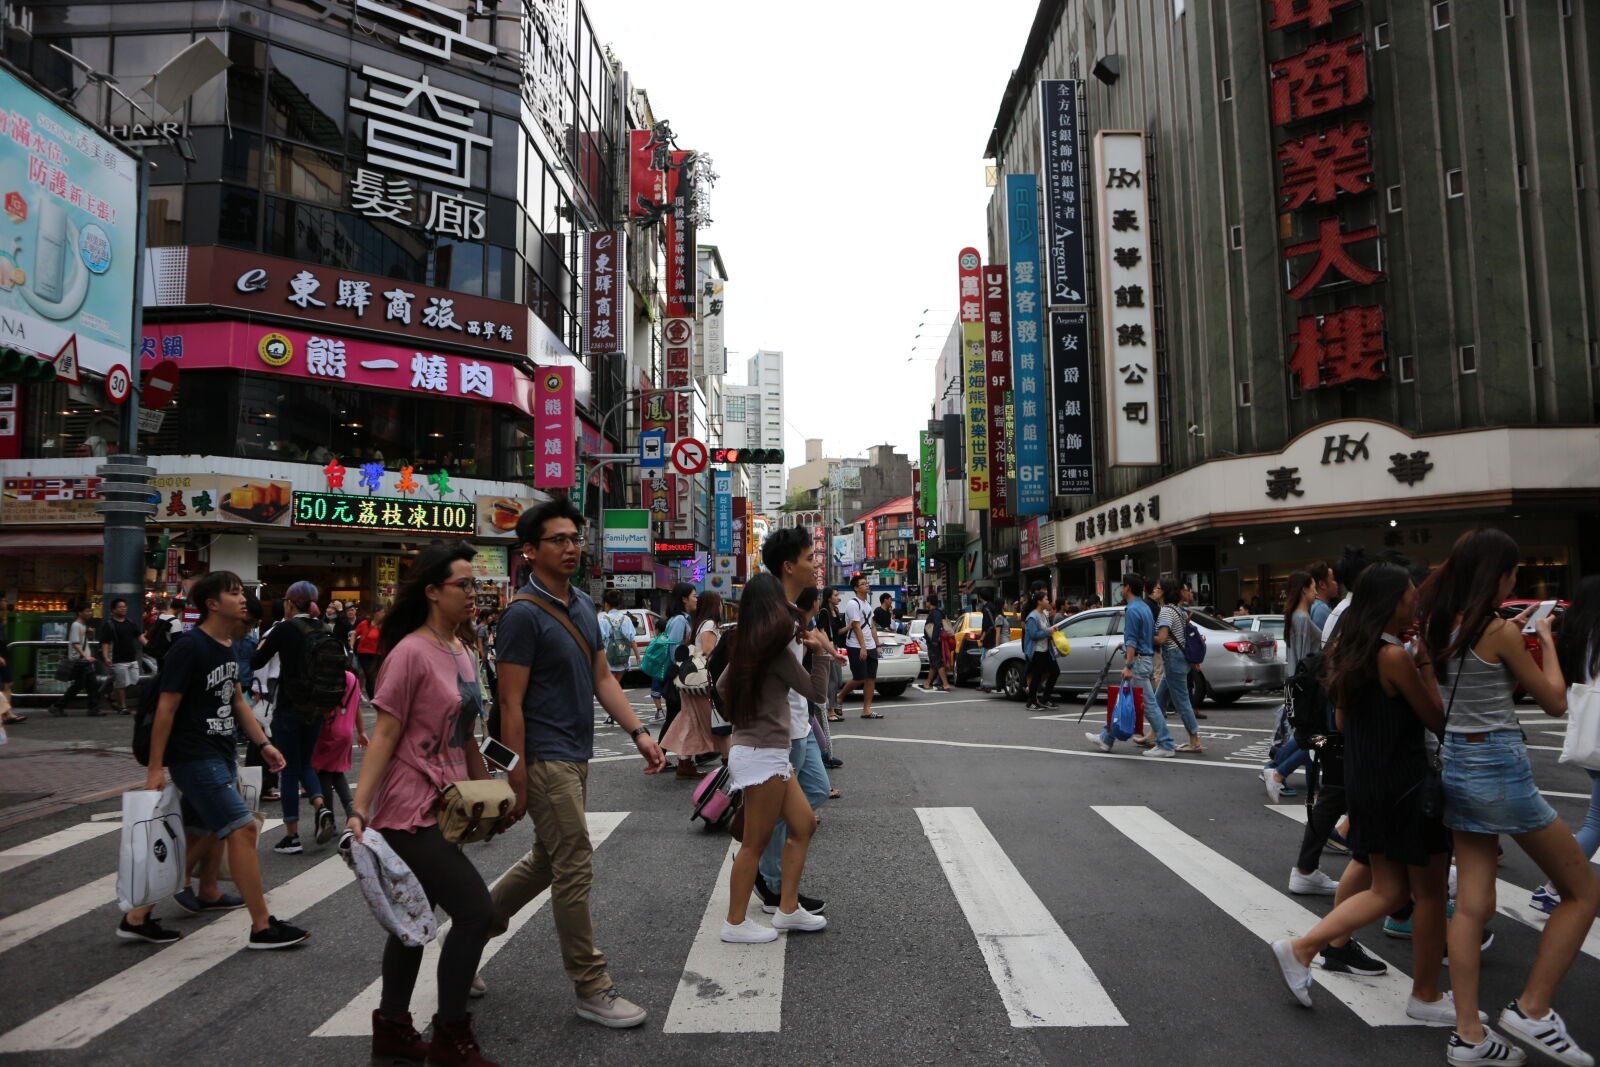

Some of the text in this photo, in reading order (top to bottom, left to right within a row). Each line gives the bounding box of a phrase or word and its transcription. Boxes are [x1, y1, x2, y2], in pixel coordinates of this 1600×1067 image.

[351, 168, 487, 240] 髮廊
[288, 270, 463, 331] 東驛商旅
[111, 375, 125, 393] 30
[306, 337, 494, 398] 熊一燒肉
[1062, 334, 1082, 450] 安爵銀飾
[544, 399, 563, 478] 熊一燒肉
[968, 360, 988, 472] 湯姆熊歡樂世界
[323, 459, 455, 497] 台灣美味
[970, 477, 989, 492] 5F
[1020, 466, 1045, 481] 6F
[606, 533, 647, 544] FamilyMart
